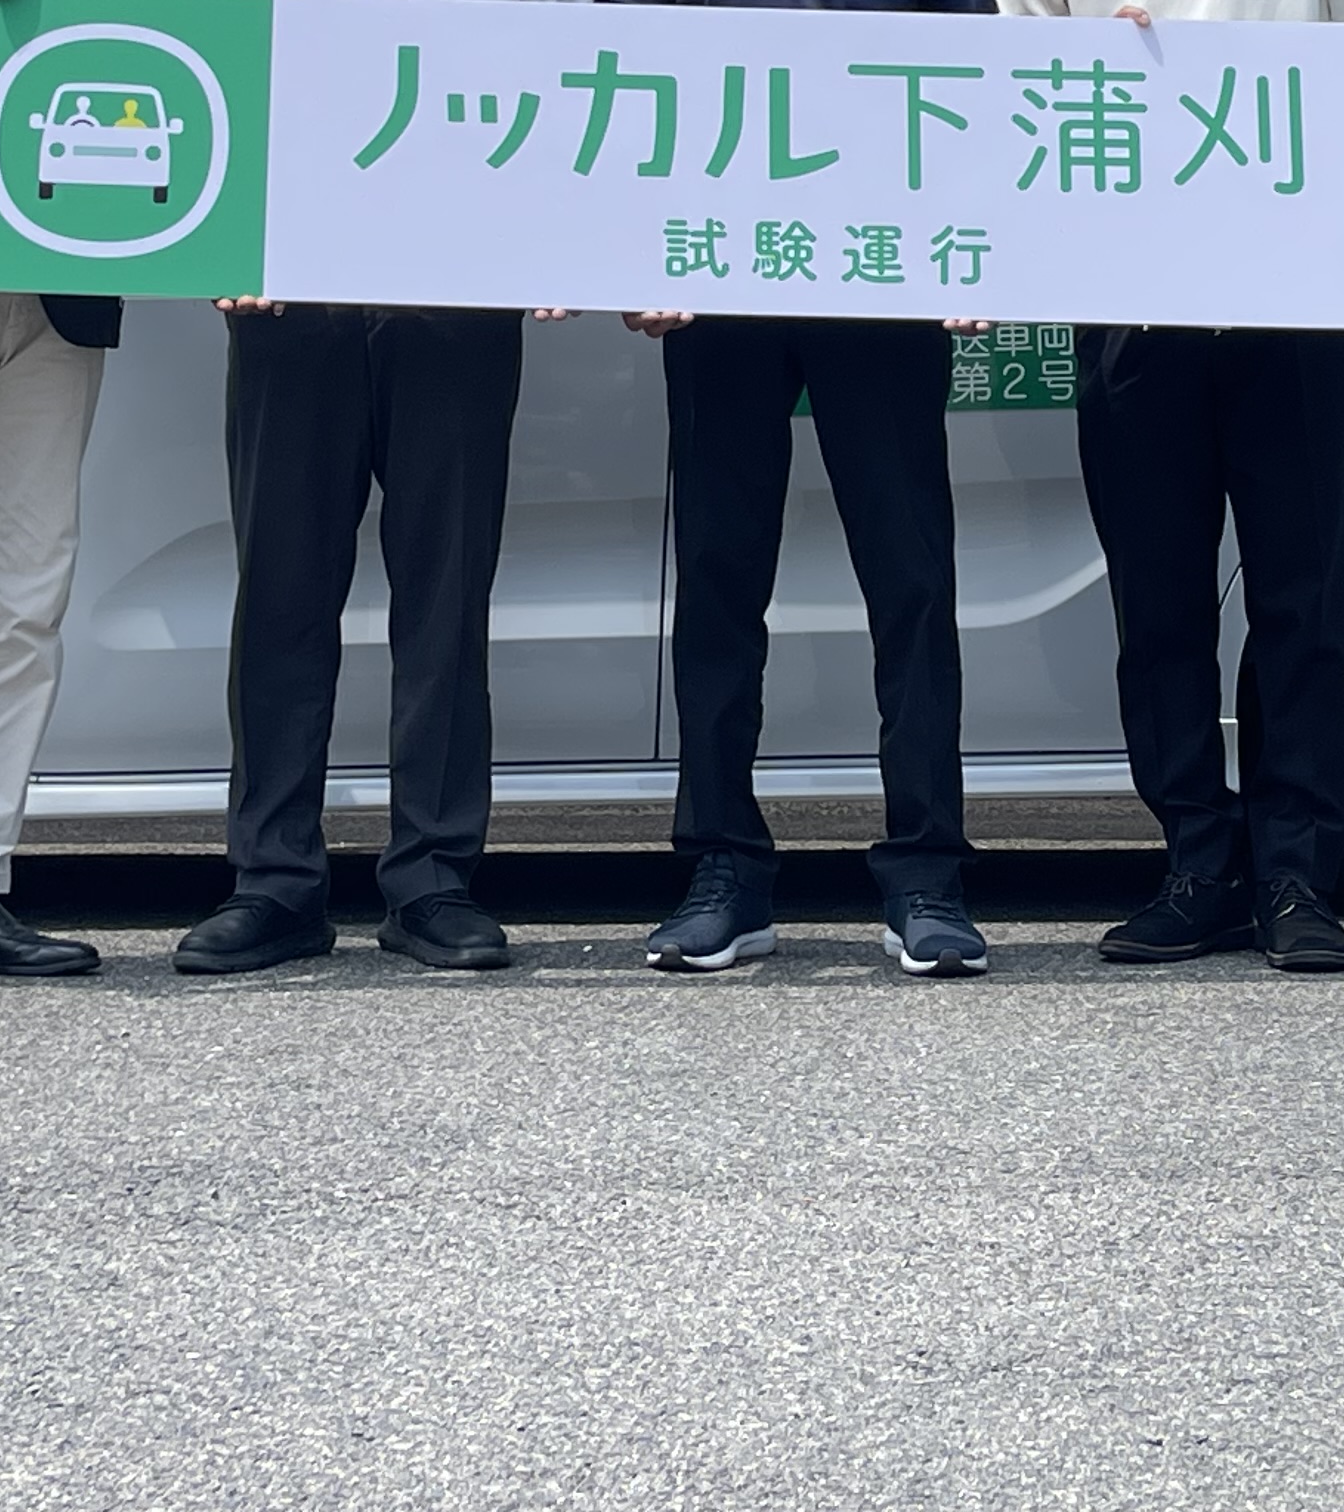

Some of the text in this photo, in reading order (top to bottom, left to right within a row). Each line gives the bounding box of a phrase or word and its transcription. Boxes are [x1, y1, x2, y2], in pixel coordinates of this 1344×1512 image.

[353, 45, 1306, 194] ノッカル下蒲刈
[665, 219, 993, 286] 試験運行
